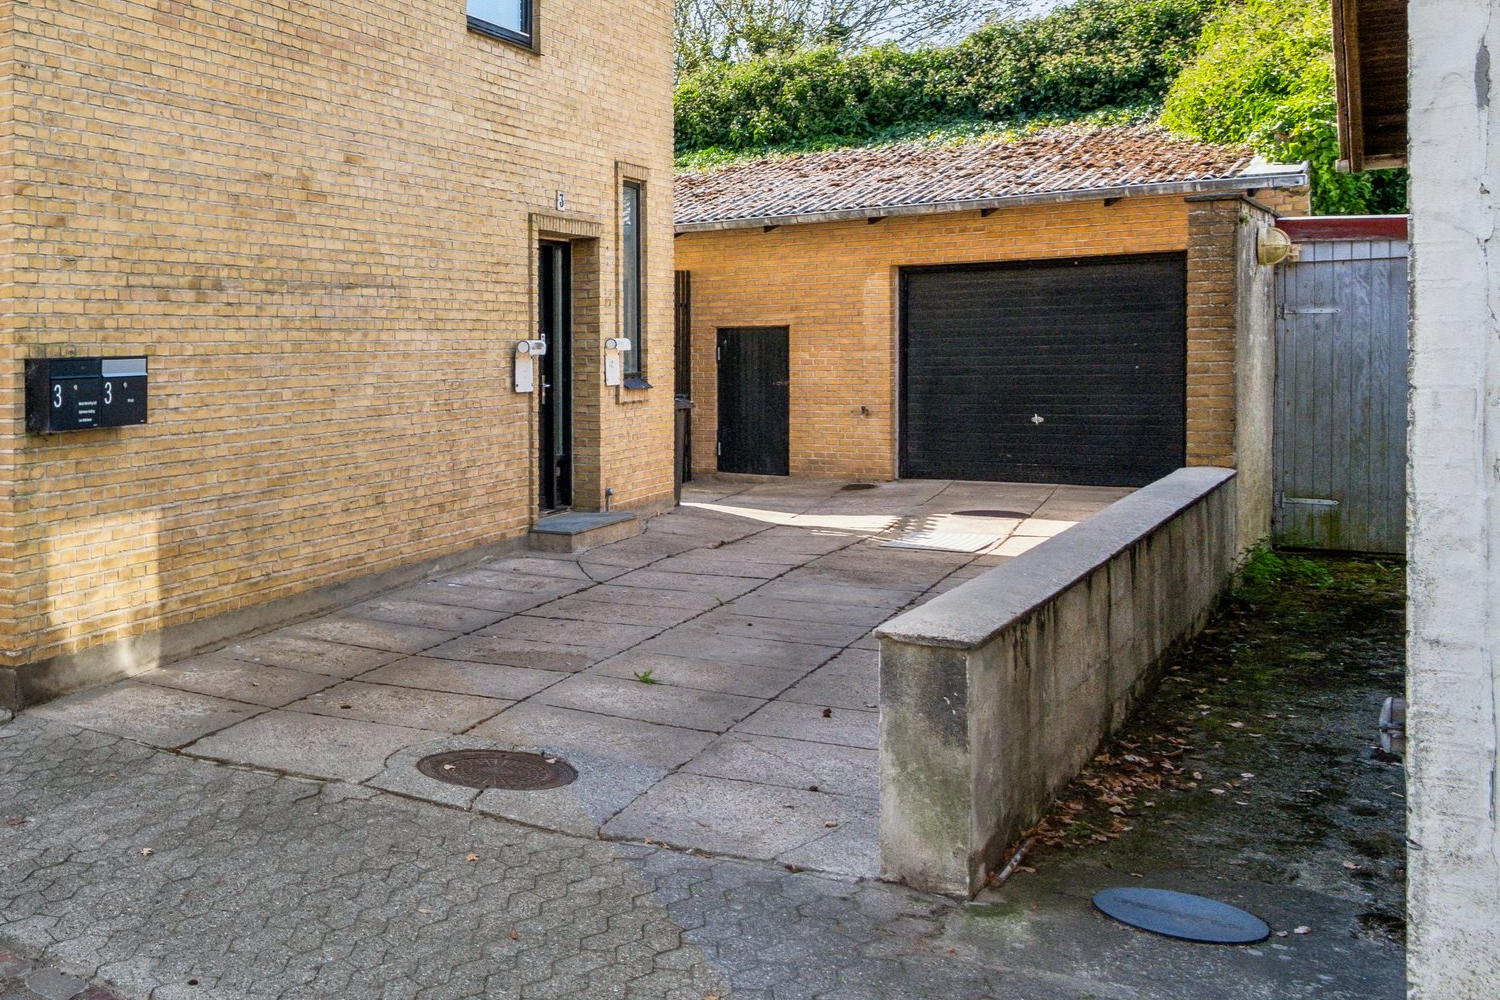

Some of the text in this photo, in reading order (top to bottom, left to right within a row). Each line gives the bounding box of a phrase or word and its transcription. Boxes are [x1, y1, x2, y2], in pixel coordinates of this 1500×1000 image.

[559, 193, 565, 208] 3
[53, 384, 62, 408] 3
[104, 381, 112, 404] 3
